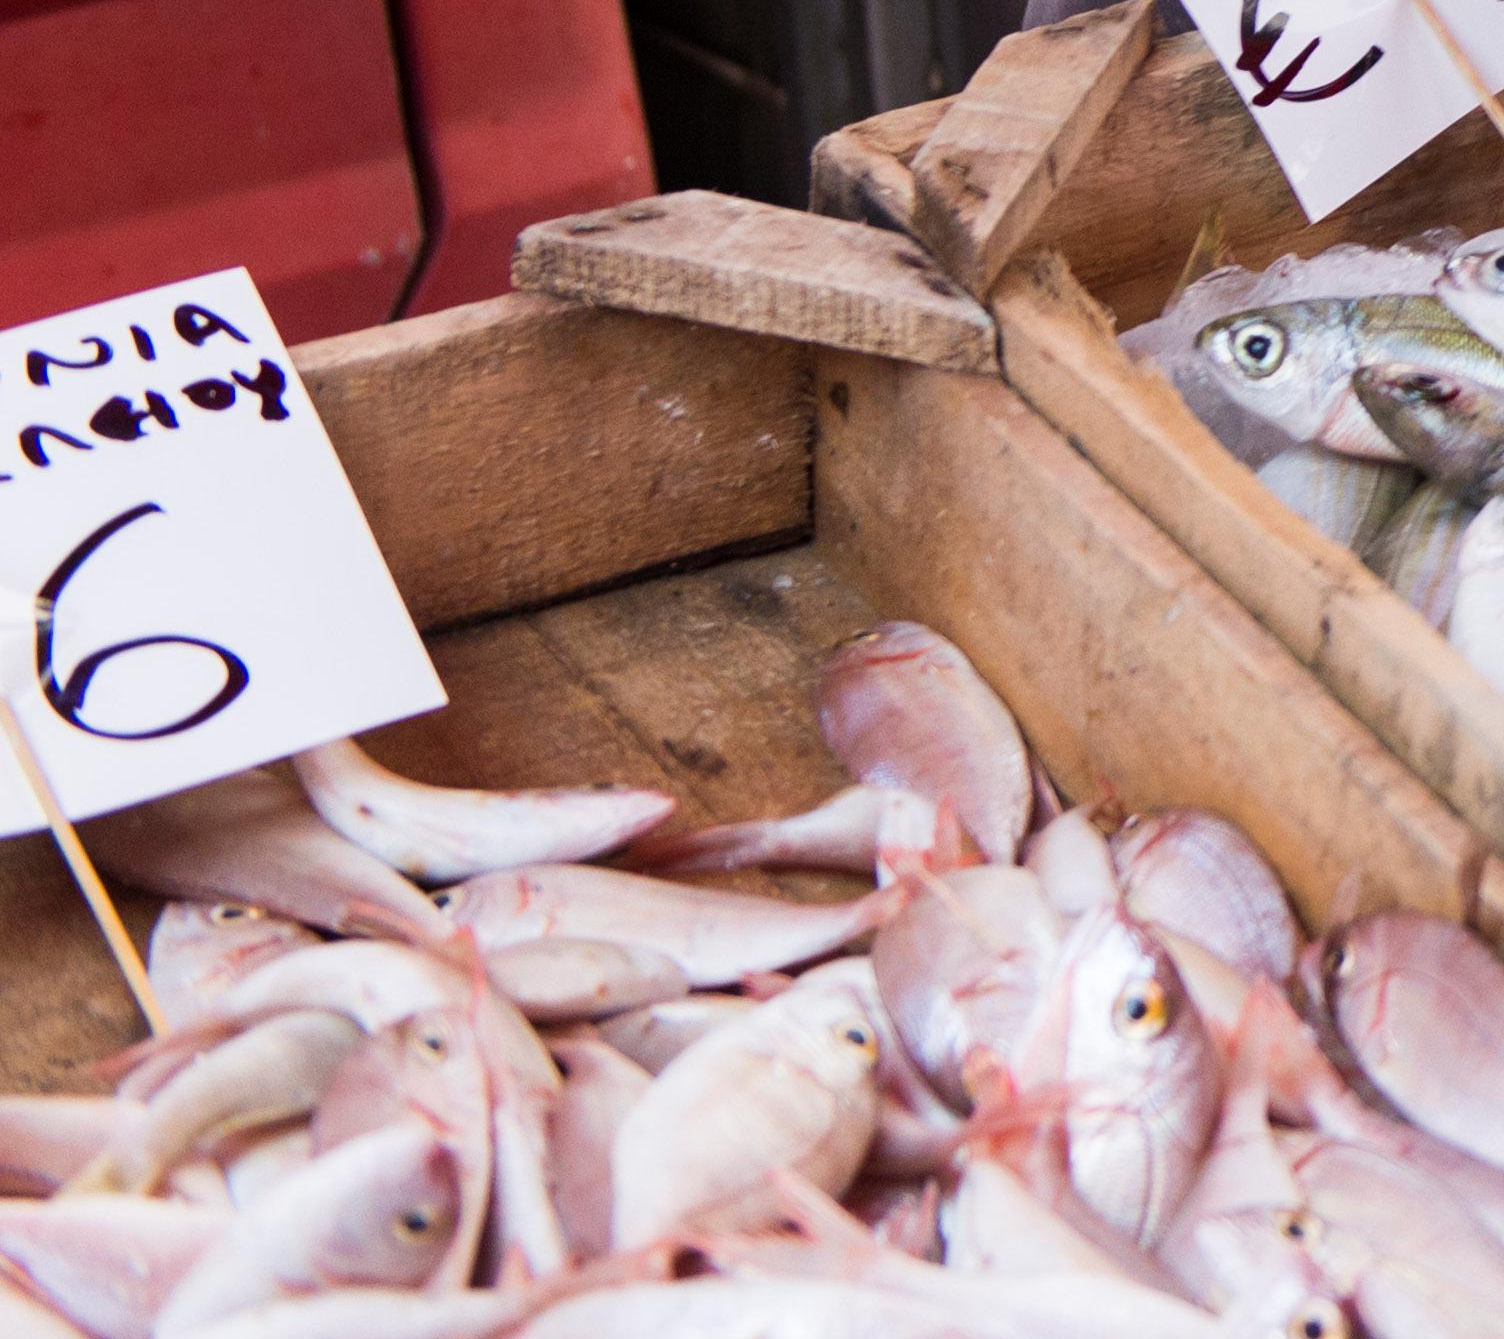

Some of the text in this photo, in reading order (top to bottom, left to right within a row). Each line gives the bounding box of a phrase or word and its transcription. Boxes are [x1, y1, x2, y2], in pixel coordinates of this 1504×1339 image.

[25, 303, 251, 386] ΝΙΑ
[0, 357, 291, 481] ΛΕΙΟΥ
[34, 500, 251, 742] 6
